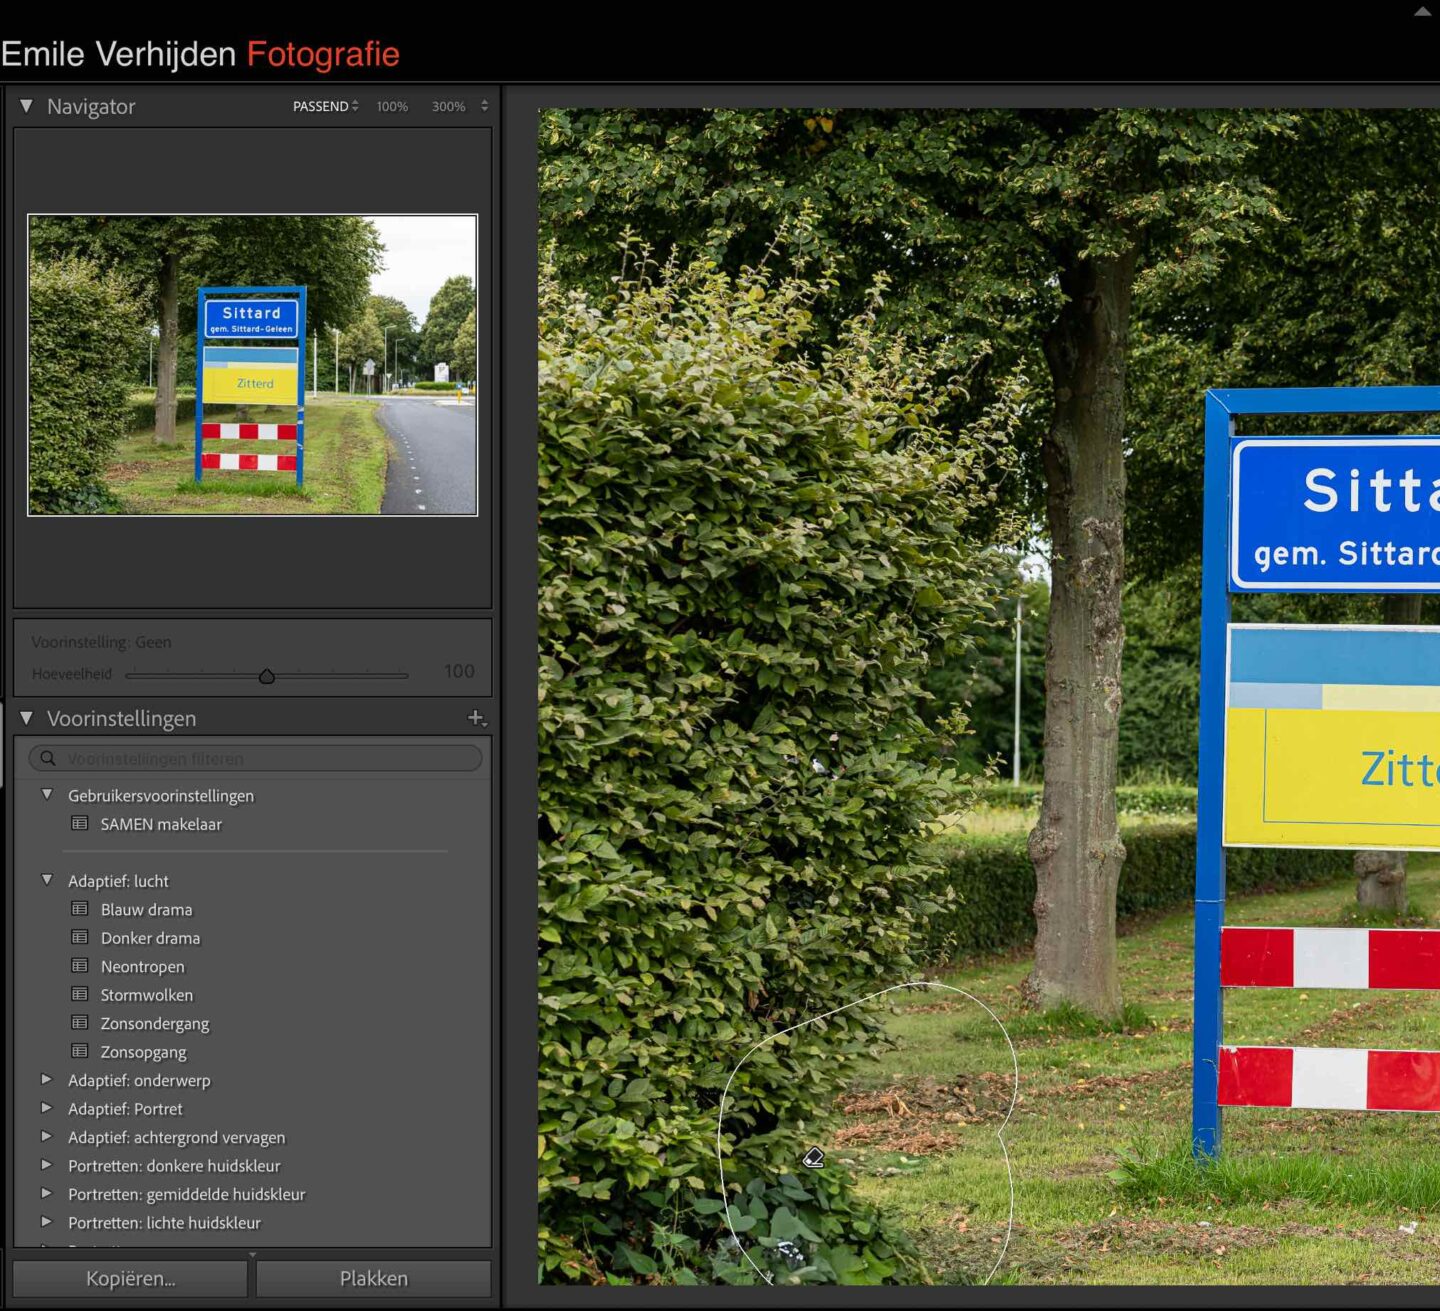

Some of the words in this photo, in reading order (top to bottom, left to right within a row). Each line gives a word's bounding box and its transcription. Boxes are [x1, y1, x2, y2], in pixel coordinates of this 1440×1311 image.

[1, 41, 84, 66] Emile
[96, 41, 235, 73] Verhijden
[249, 41, 399, 73] Fotografie
[49, 98, 135, 119] Navigator
[294, 101, 348, 111] PASSEND
[378, 101, 408, 111] 100%
[433, 101, 465, 111] 300%
[223, 307, 280, 319] Sittard
[237, 379, 273, 388] Zitterd
[1255, 547, 1326, 572] gem.
[32, 635, 130, 652] Voorinstelling:
[136, 636, 171, 648] Geen
[32, 668, 112, 680] Hoeveelheid
[445, 664, 475, 678] 100
[47, 710, 195, 732] Voorinstellingen
[69, 753, 186, 768] Voorinstellingen
[192, 752, 243, 765] filteren
[69, 789, 253, 806] Gebruikersvoorinstellingen
[102, 818, 152, 830] SAMEN
[158, 817, 222, 830] makelaar
[69, 874, 129, 891] Adaptief:
[135, 874, 168, 887] lucht
[102, 903, 144, 916] Blauw
[149, 903, 192, 916] drama
[102, 931, 152, 944] Donker
[156, 931, 200, 944] drama
[102, 961, 184, 976] Neontropen
[102, 988, 192, 1001] Stormwolken
[101, 1017, 209, 1033] Zonsondergang
[101, 1046, 187, 1062] Zonsopgang
[69, 1073, 129, 1090] Adaptief:
[135, 1073, 210, 1090] onderwerp
[68, 1102, 129, 1118] Adaptief:
[135, 1103, 182, 1115] Portret
[68, 1130, 129, 1147] Adaptief:
[135, 1130, 217, 1147] achtergrond
[223, 1134, 285, 1147] vervagen
[69, 1160, 142, 1172] Portretten:
[147, 1159, 203, 1172] donkere
[208, 1159, 280, 1172] huidskleur
[69, 1188, 142, 1200] Portretten:
[147, 1187, 228, 1204] gemiddelde
[234, 1187, 305, 1200] huidskleur
[69, 1217, 142, 1229] Portretten:
[148, 1216, 184, 1229] lichte
[189, 1216, 261, 1229] huidskleur
[88, 1271, 175, 1290] Kopiëren...
[341, 1270, 407, 1286] Plakken
